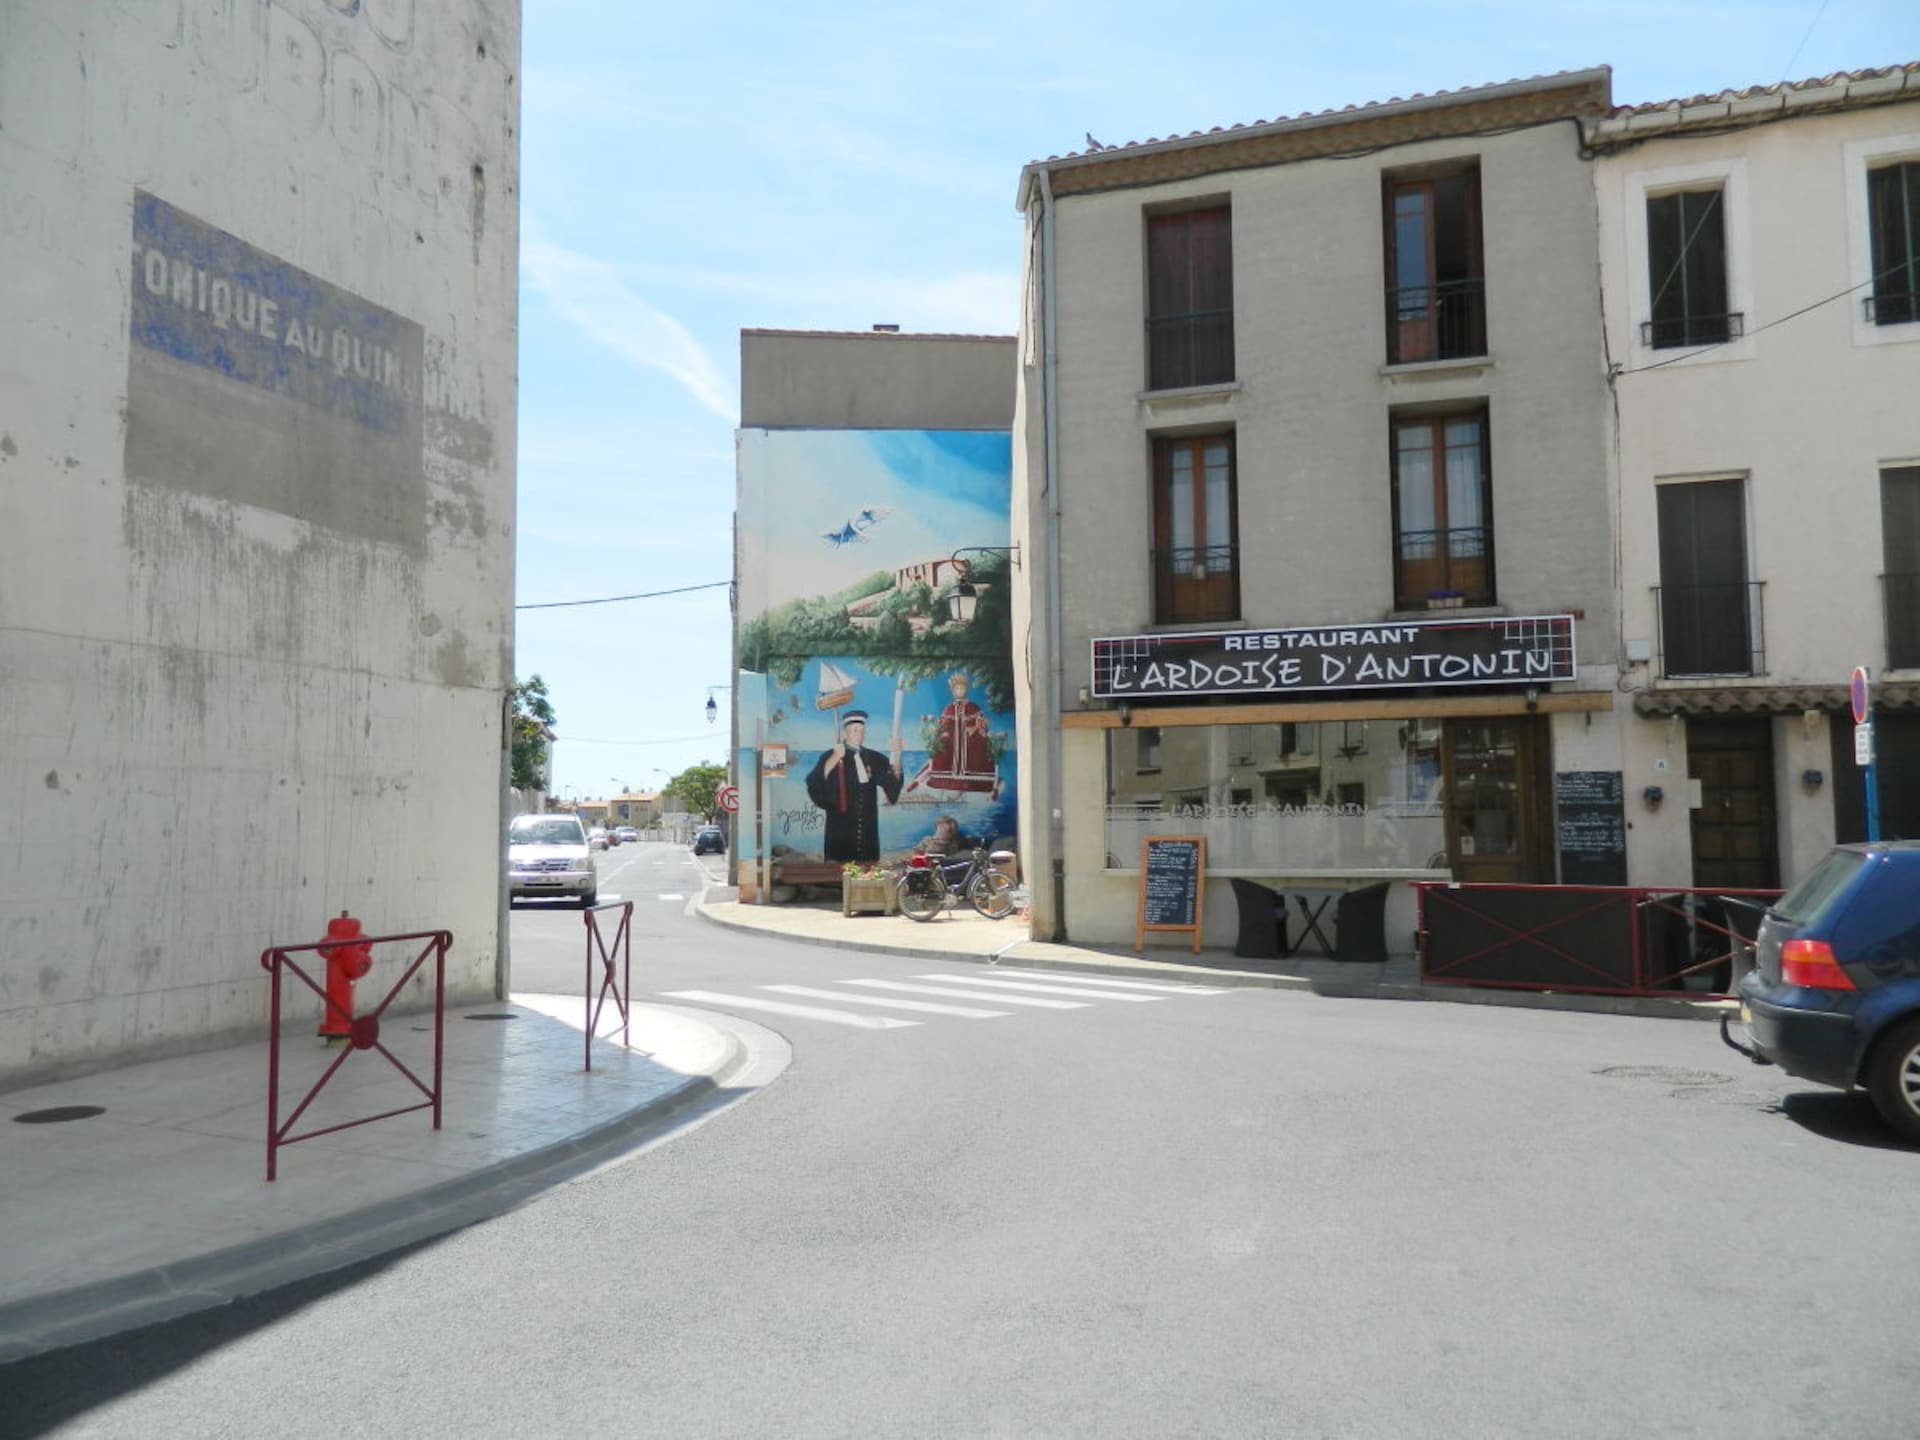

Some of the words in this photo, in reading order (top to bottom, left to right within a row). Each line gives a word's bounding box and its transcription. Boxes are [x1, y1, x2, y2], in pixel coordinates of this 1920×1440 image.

[133, 243, 279, 341] ONIQUE
[284, 317, 324, 359] AU
[1224, 628, 1419, 651] RESTAURANT
[1113, 652, 1302, 690] L'ARDOISE
[1320, 650, 1549, 684] D'ANTONIN
